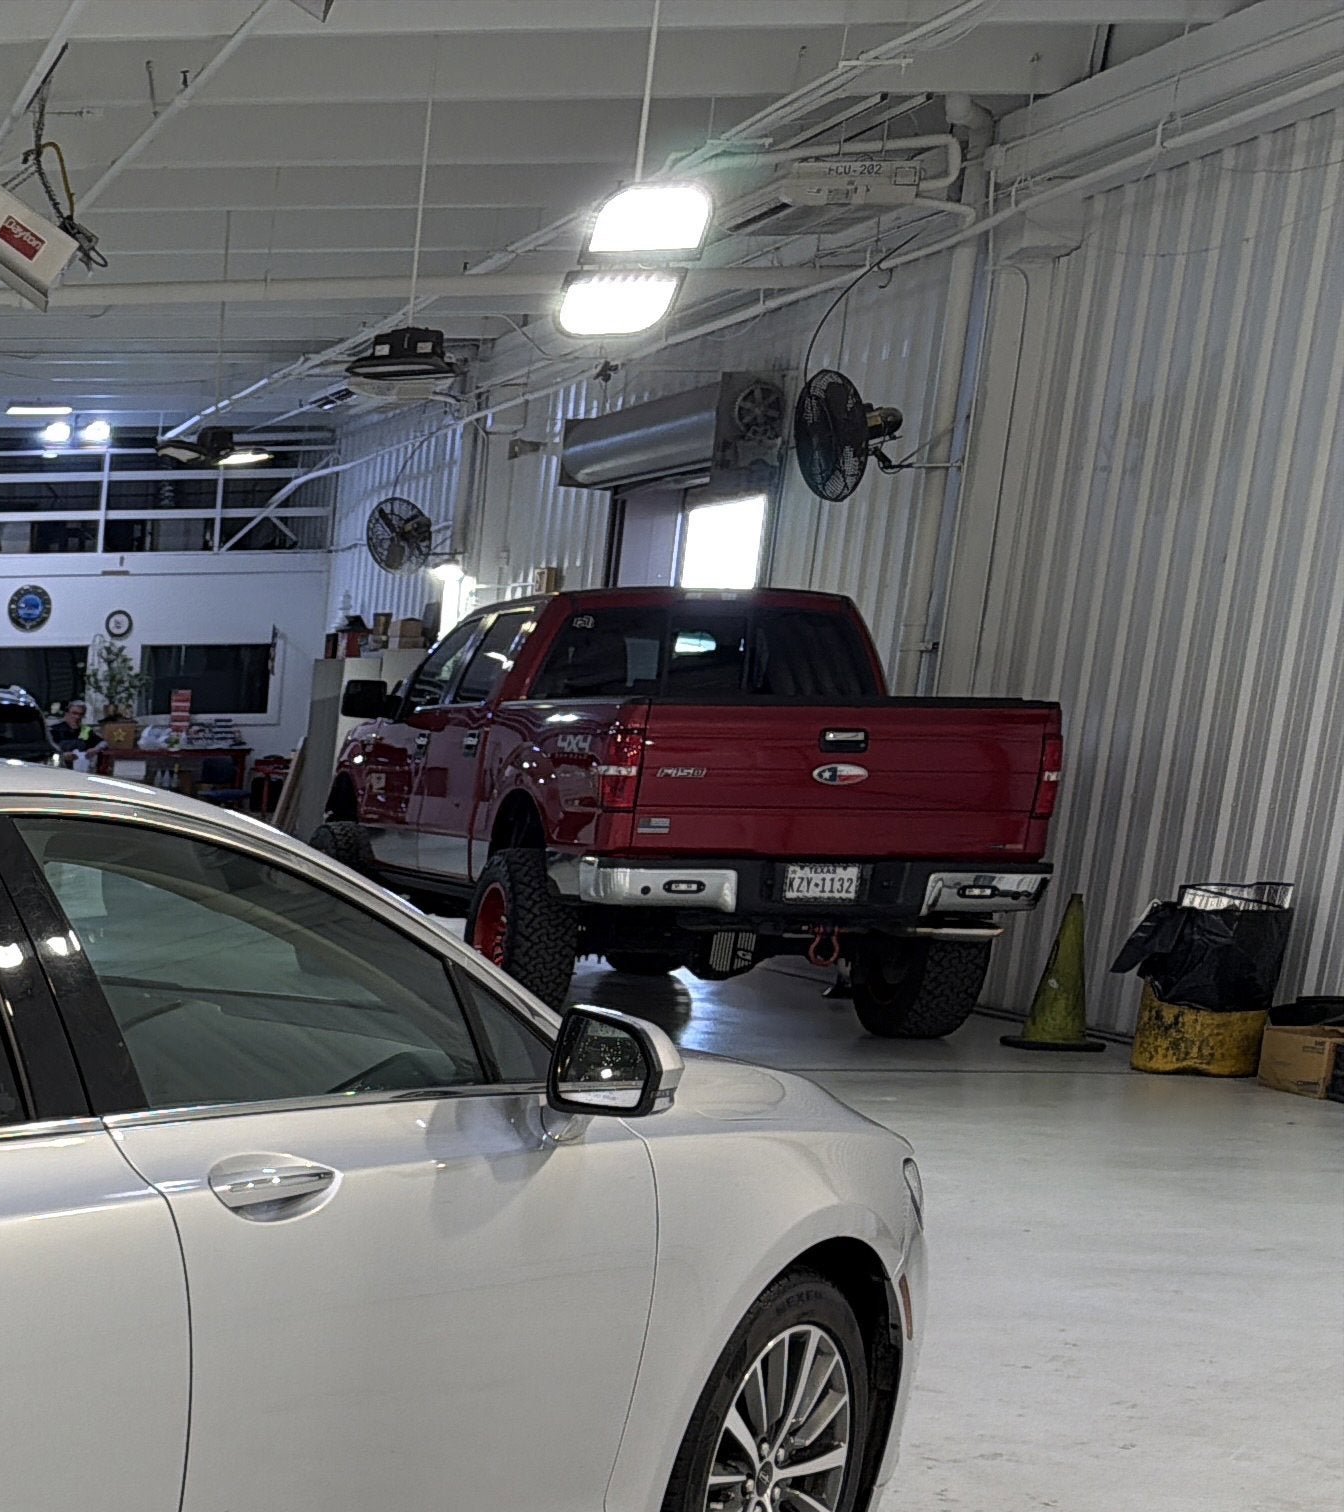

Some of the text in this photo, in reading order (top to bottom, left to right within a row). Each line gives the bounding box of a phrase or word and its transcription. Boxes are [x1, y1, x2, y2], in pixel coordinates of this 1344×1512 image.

[827, 163, 882, 176] FCU-202
[6, 218, 43, 250] Dayton
[808, 865, 838, 875] TEXAS
